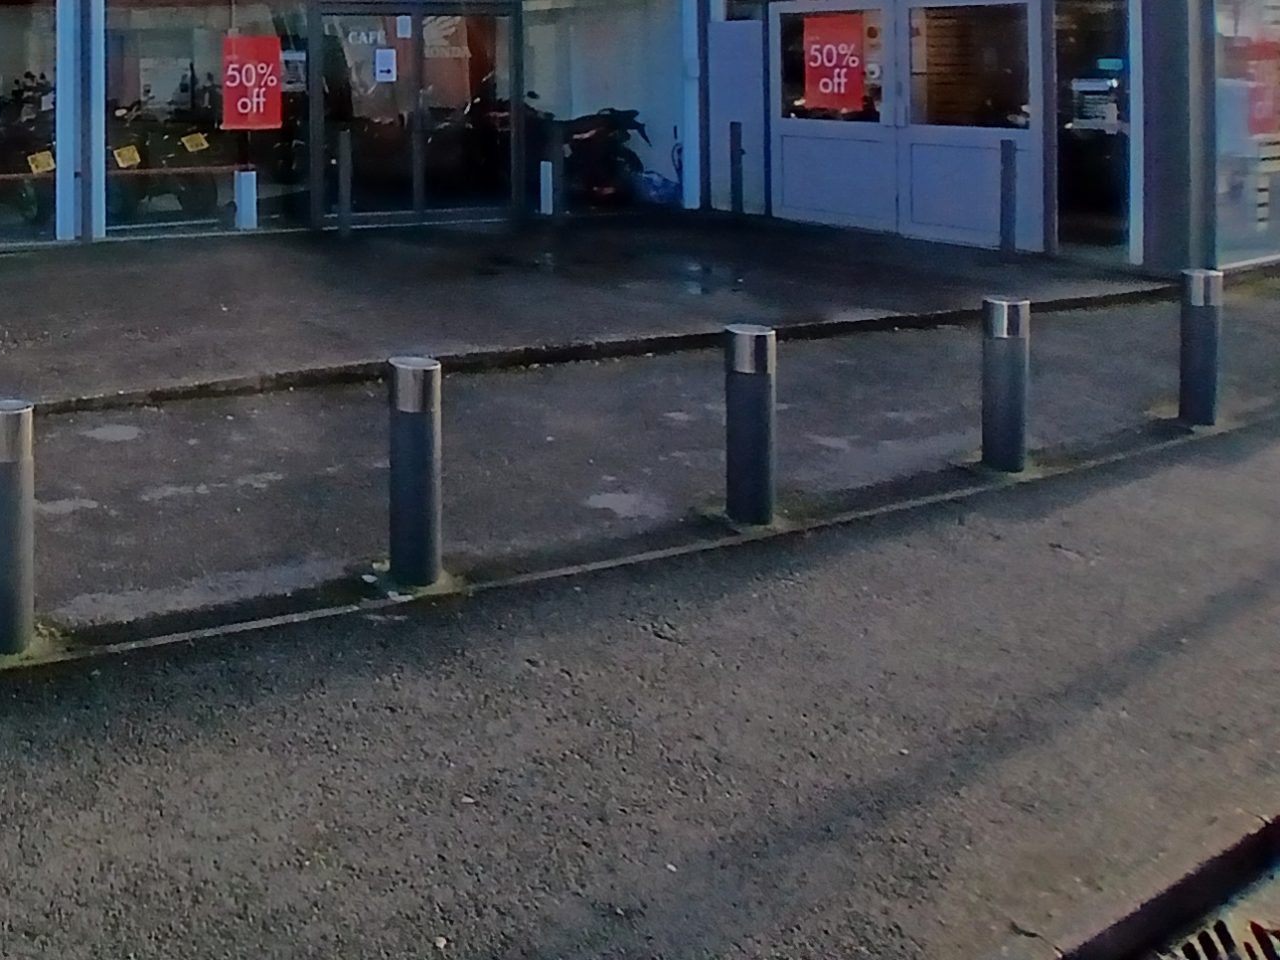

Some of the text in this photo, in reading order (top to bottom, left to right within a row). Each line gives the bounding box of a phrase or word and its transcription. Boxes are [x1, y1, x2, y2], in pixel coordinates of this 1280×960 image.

[809, 43, 860, 68] 50%
[226, 63, 277, 87] 50%
[819, 68, 848, 93] off
[237, 88, 266, 113] off
